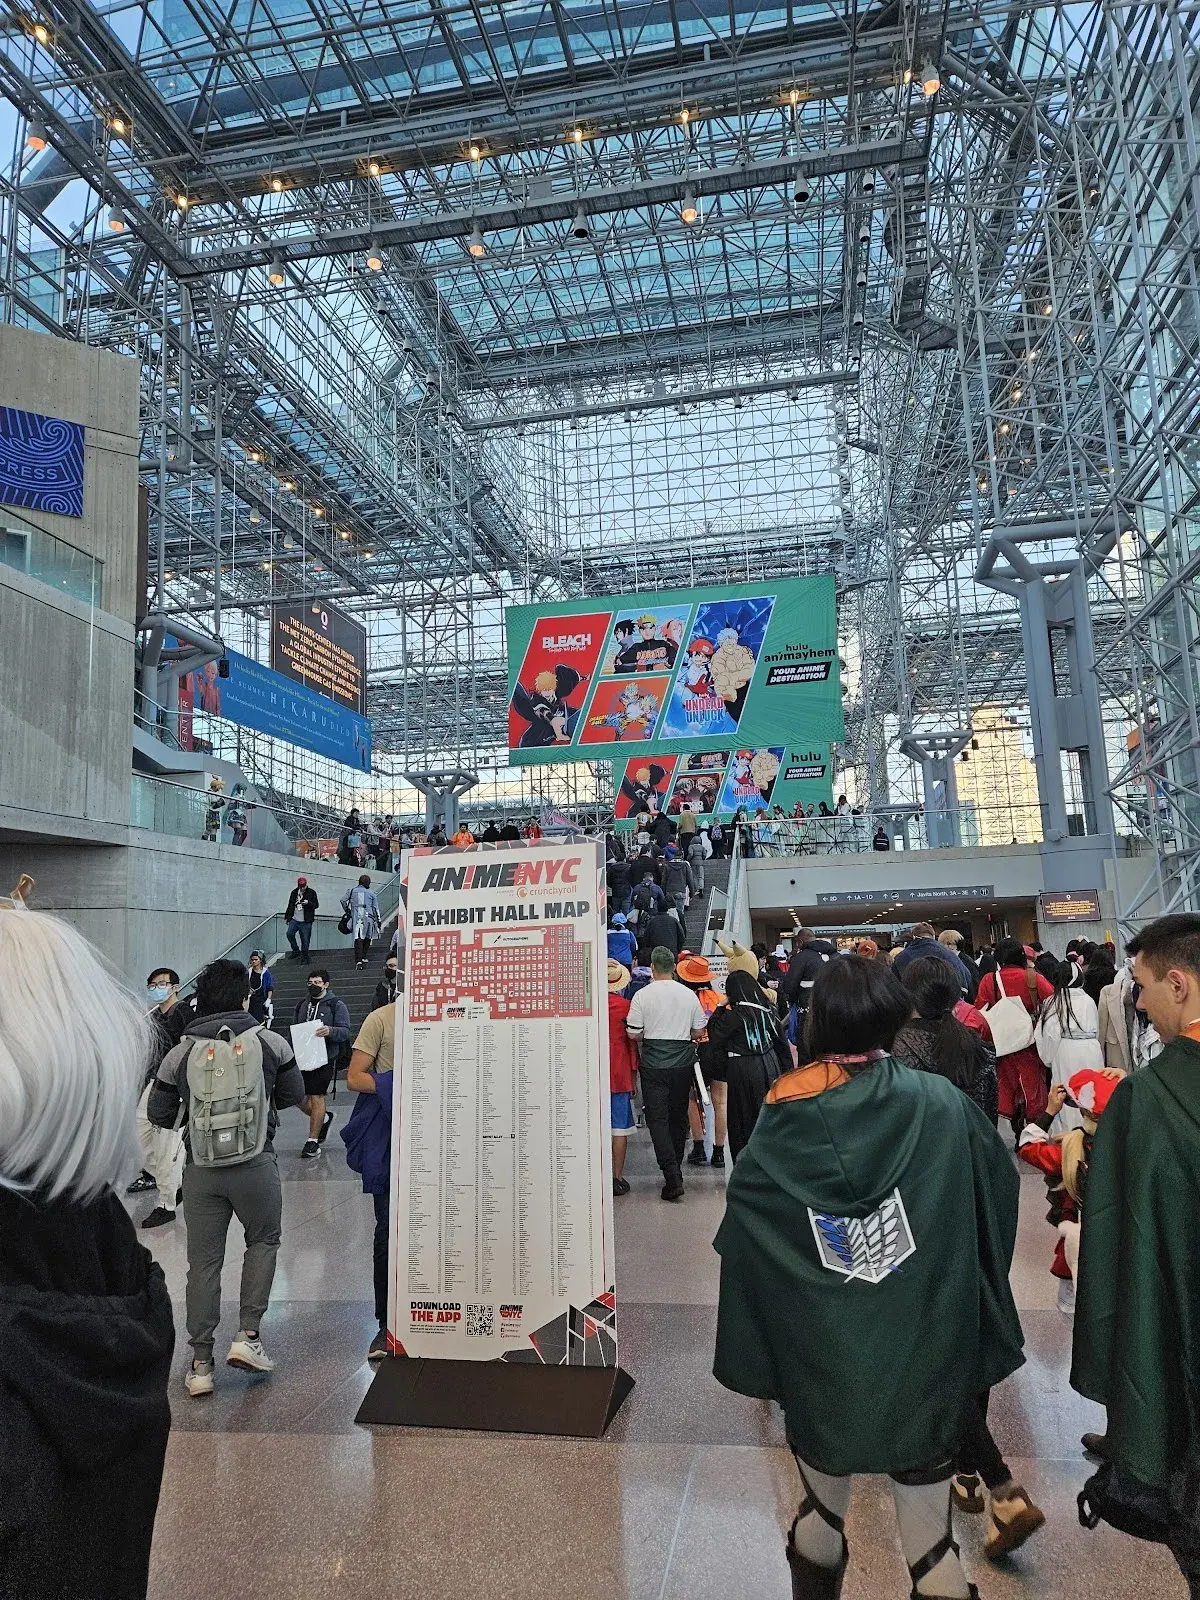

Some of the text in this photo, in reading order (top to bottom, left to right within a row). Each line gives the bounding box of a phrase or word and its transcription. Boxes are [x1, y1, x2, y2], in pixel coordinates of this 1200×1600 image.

[280, 621, 289, 633] THE
[290, 628, 300, 639] NET
[300, 634, 314, 647] ZERO
[290, 616, 300, 628] THE
[316, 633, 332, 648] CENTER
[290, 639, 294, 647] A
[542, 634, 591, 648] BLEACH
[786, 643, 808, 651] hulu
[280, 644, 300, 660] TACKLE
[764, 649, 835, 662] animayhem
[796, 665, 825, 673] ANIME
[770, 672, 826, 683] DESTINATION
[239, 681, 265, 697] SUMMER
[270, 692, 326, 726] HIKARU
[330, 722, 350, 737] DIED
[685, 696, 724, 711] UNDEAD
[686, 709, 724, 724] UNLUCK
[791, 752, 821, 762] hulu
[522, 858, 582, 886] NYC
[530, 885, 577, 896] crunchyroll
[413, 900, 590, 926] EXHIBIT HALL MAP
[411, 1301, 461, 1311] DOWNLOAD
[410, 1310, 461, 1323] THE APP
